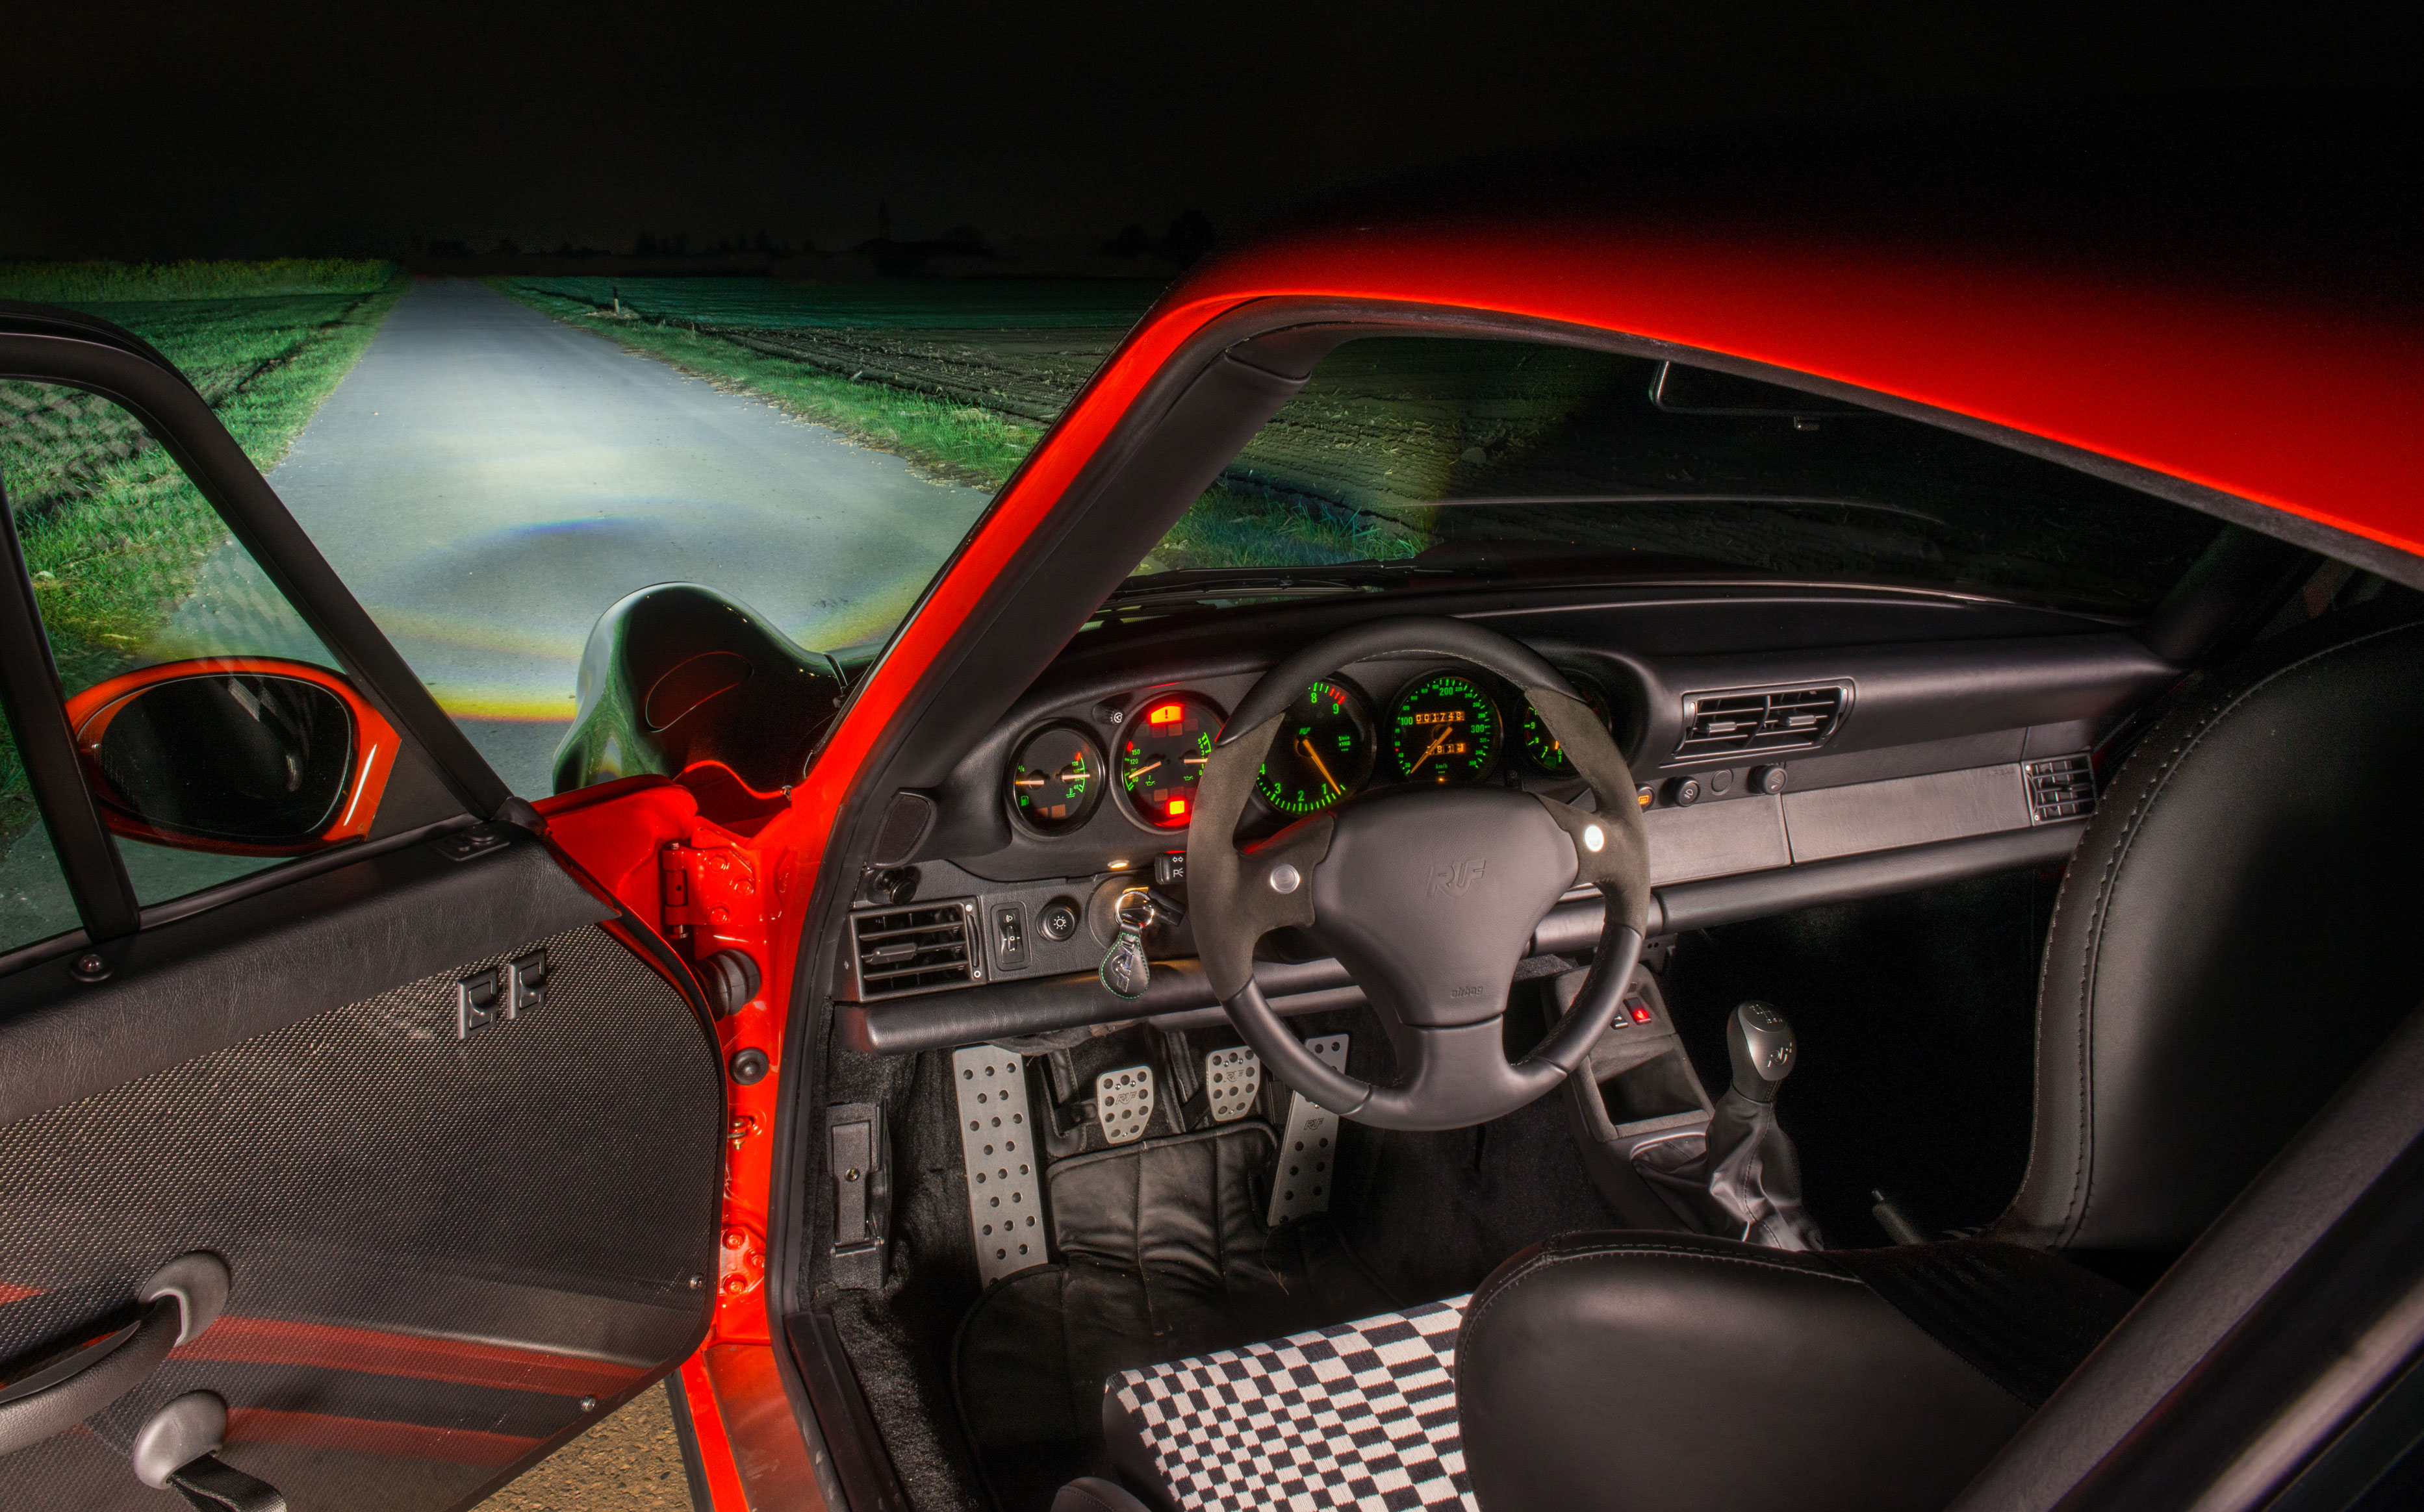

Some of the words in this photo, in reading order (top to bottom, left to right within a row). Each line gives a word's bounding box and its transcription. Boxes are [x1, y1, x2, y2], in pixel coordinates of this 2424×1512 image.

[1439, 687, 1453, 696] 200
[1310, 692, 1317, 703] 8
[1333, 703, 1339, 714] 9
[1401, 716, 1413, 725] 100
[1416, 712, 1462, 722] 001748
[1470, 724, 1485, 733] 300
[1259, 763, 1266, 775] 4
[1275, 783, 1281, 794] 3
[1321, 783, 1327, 794] 1
[1298, 790, 1305, 801] 2
[1425, 859, 1486, 899] RUF
[1451, 986, 1483, 998] airbag
[1223, 1069, 1244, 1082] RUF
[1115, 1091, 1137, 1105] RUF
[1304, 1117, 1324, 1130] RUF
